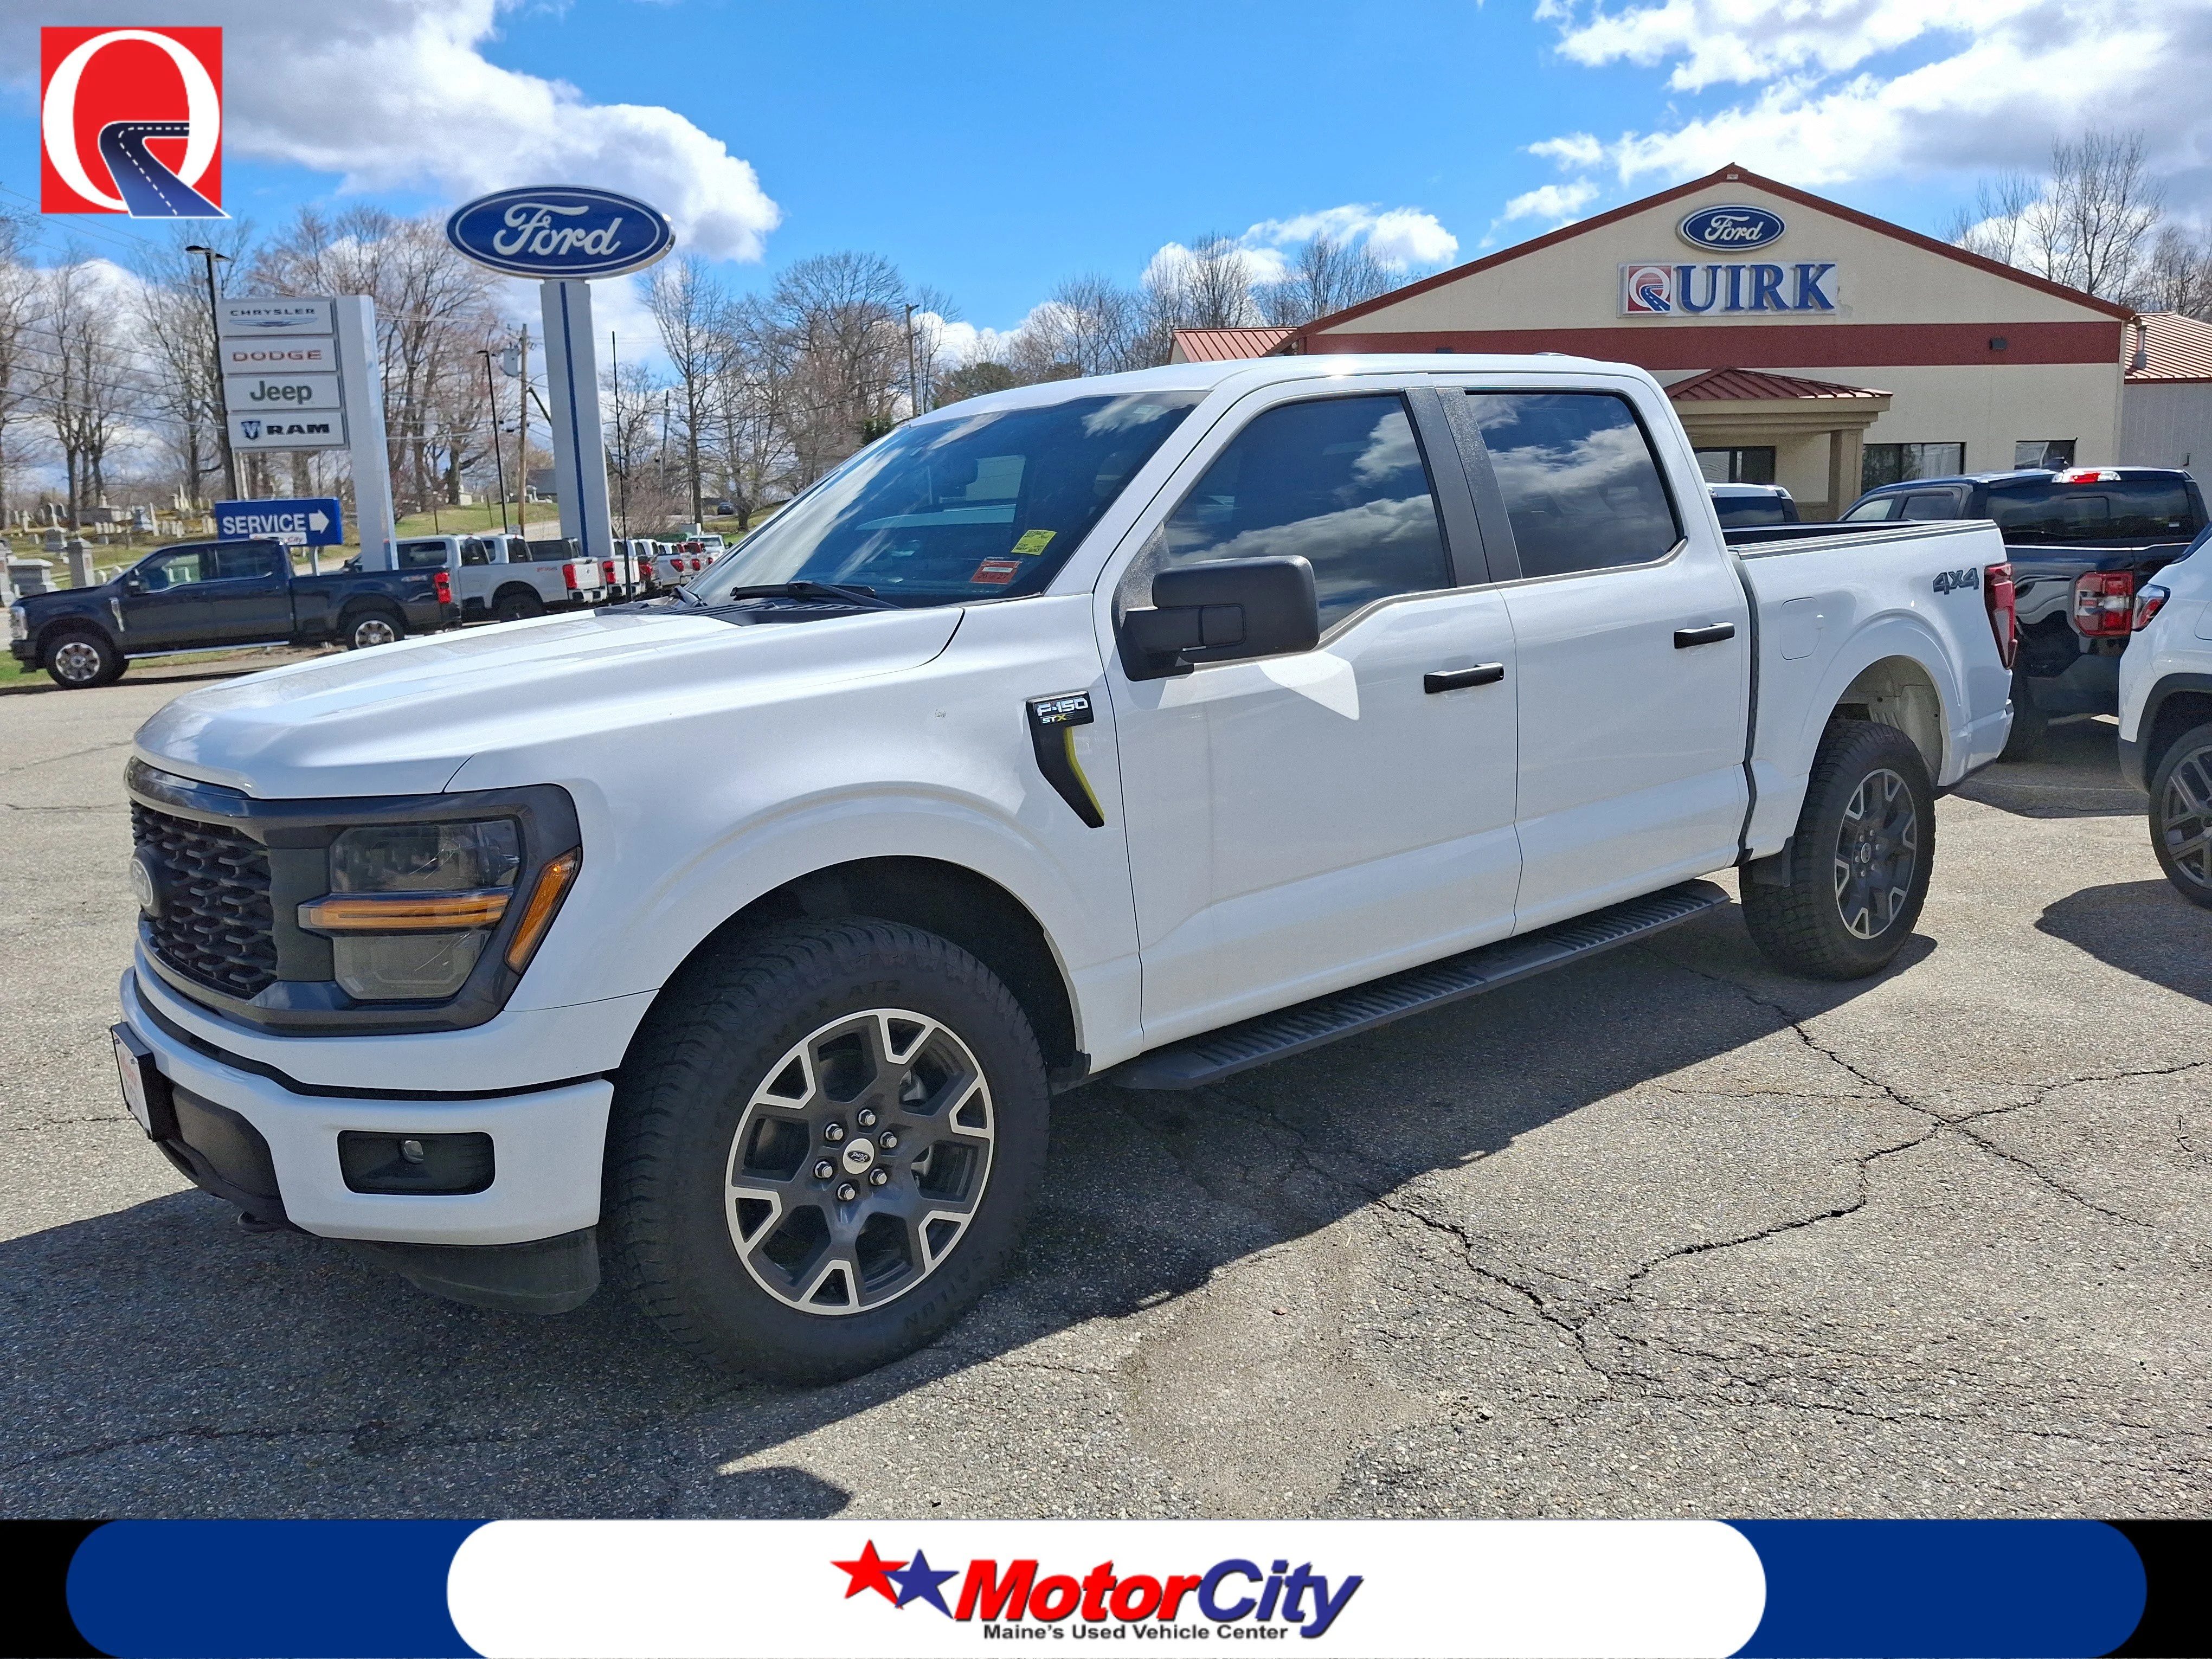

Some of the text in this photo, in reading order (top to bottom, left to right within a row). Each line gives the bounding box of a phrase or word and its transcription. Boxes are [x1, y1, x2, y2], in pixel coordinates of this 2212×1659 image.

[493, 203, 623, 255] Ford
[1704, 215, 1763, 241] Ford
[233, 350, 322, 362] DODGE
[250, 381, 312, 405] Jeep
[267, 424, 330, 435] RAM
[223, 514, 307, 535] SERVICE
[1036, 697, 1089, 716] F-150
[1042, 714, 1067, 724] STX
[847, 979, 901, 998] AT2
[851, 1152, 868, 1162] Ford
